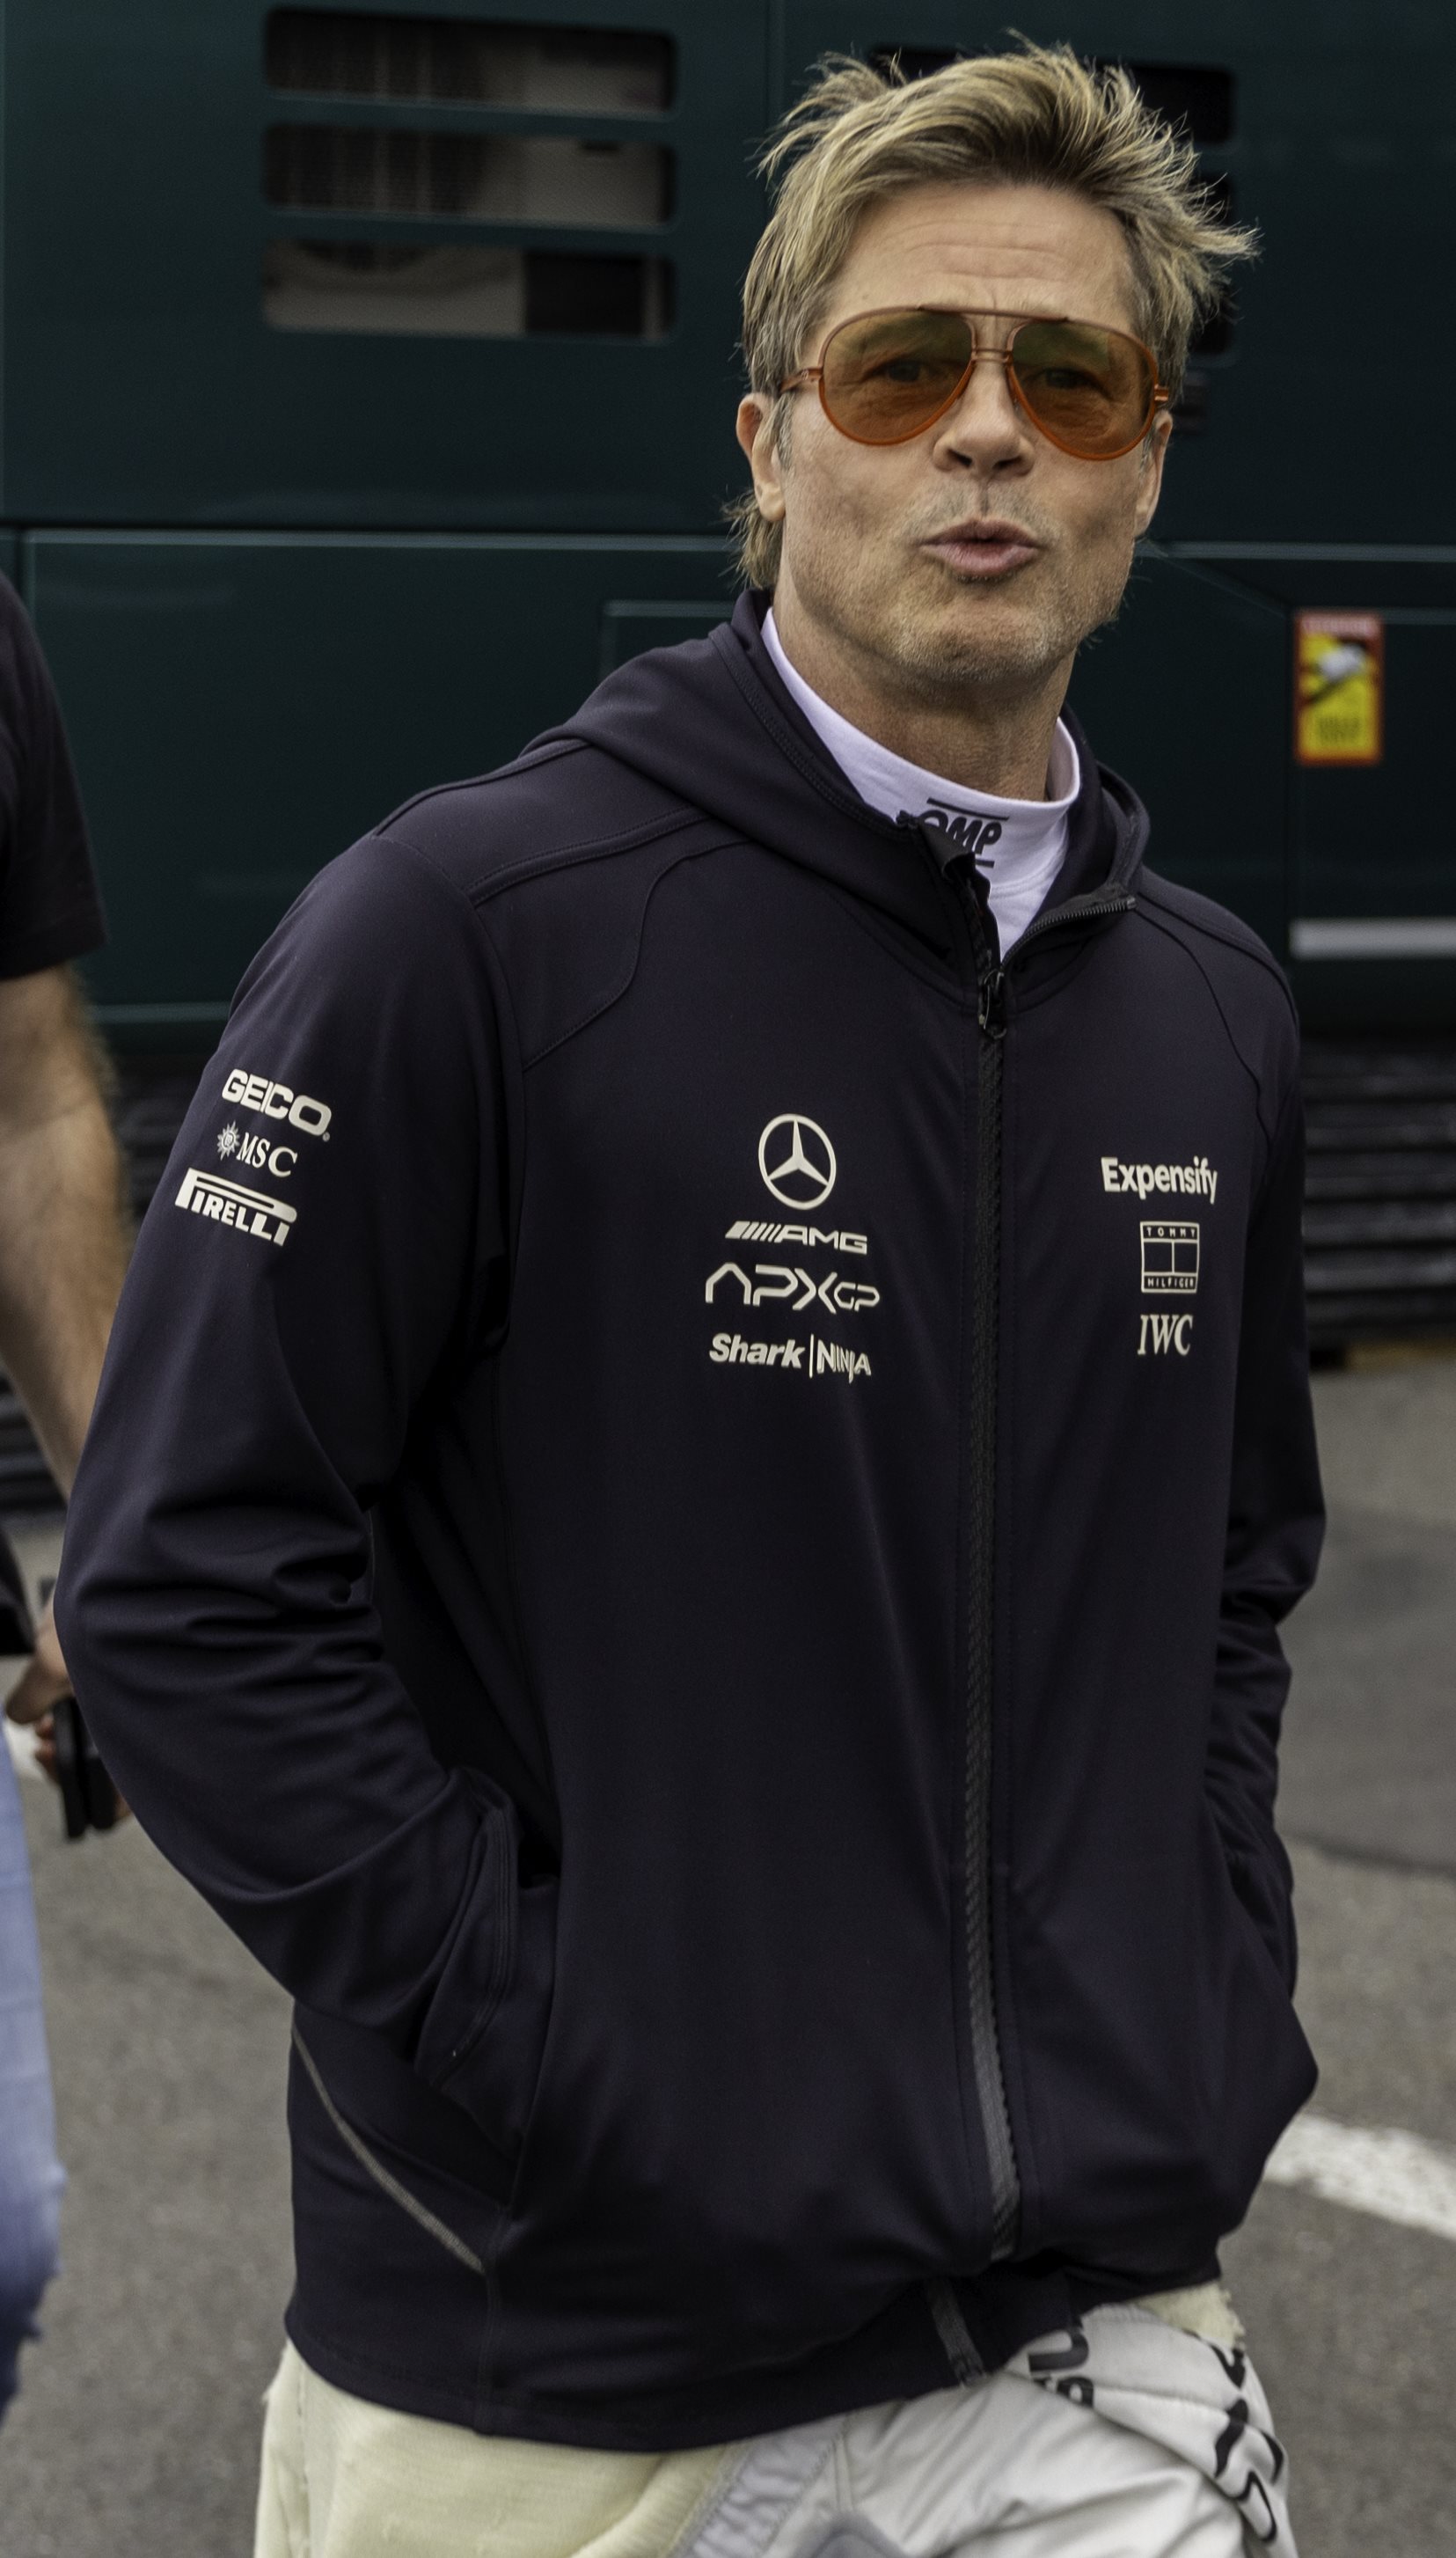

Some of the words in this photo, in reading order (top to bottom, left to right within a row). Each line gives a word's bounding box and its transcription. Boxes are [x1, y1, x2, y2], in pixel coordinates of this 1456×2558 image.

[222, 1068, 332, 1137] GEICO
[236, 1132, 298, 1177] MSC
[1101, 1156, 1218, 1205] Expensify
[175, 1168, 297, 1246] PIRELLI
[774, 1224, 867, 1255] AMG
[1146, 1227, 1196, 1238] TOMMY
[1147, 1277, 1196, 1288] HILFIGER
[1138, 1314, 1193, 1356] IWC
